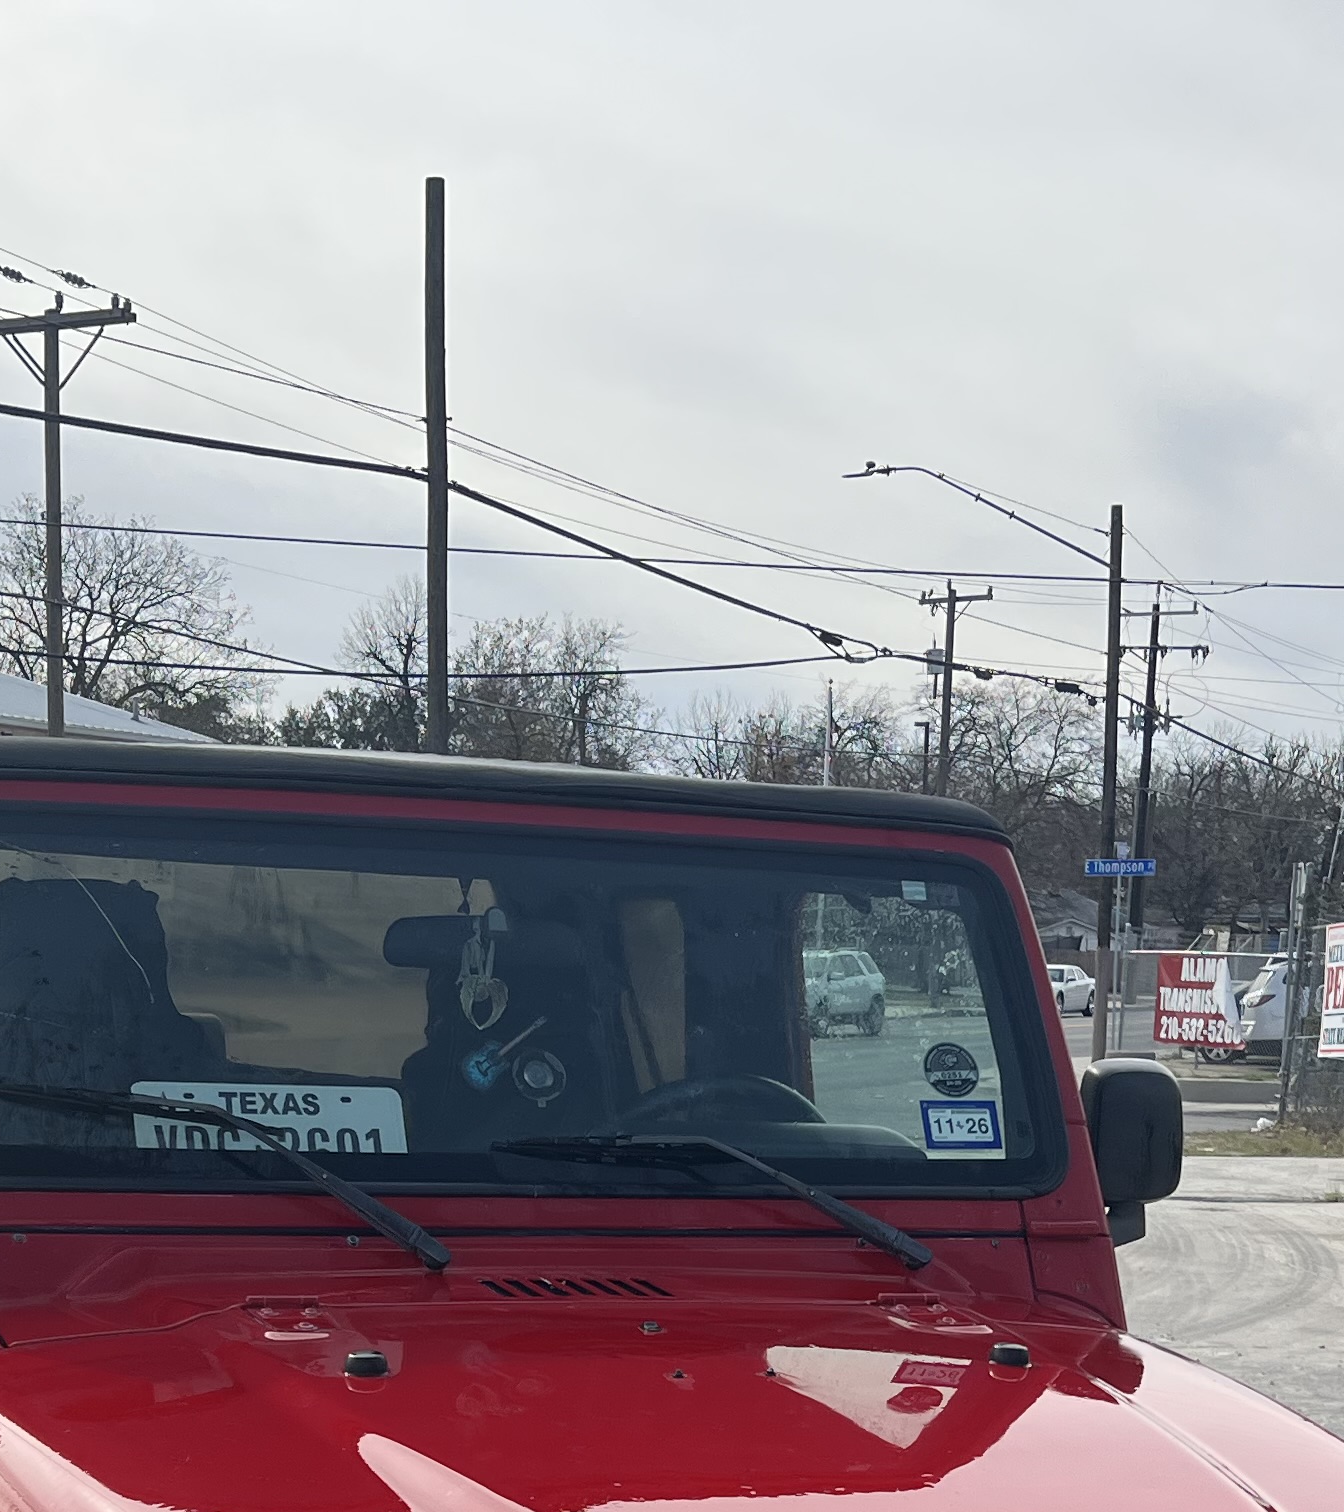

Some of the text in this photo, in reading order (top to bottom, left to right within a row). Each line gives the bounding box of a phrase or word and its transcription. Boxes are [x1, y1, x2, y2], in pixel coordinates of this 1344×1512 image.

[1084, 861, 1090, 874] E
[1094, 860, 1144, 876] Thompson
[218, 1091, 321, 1117] TEXAS
[933, 1117, 990, 1135] 11 26
